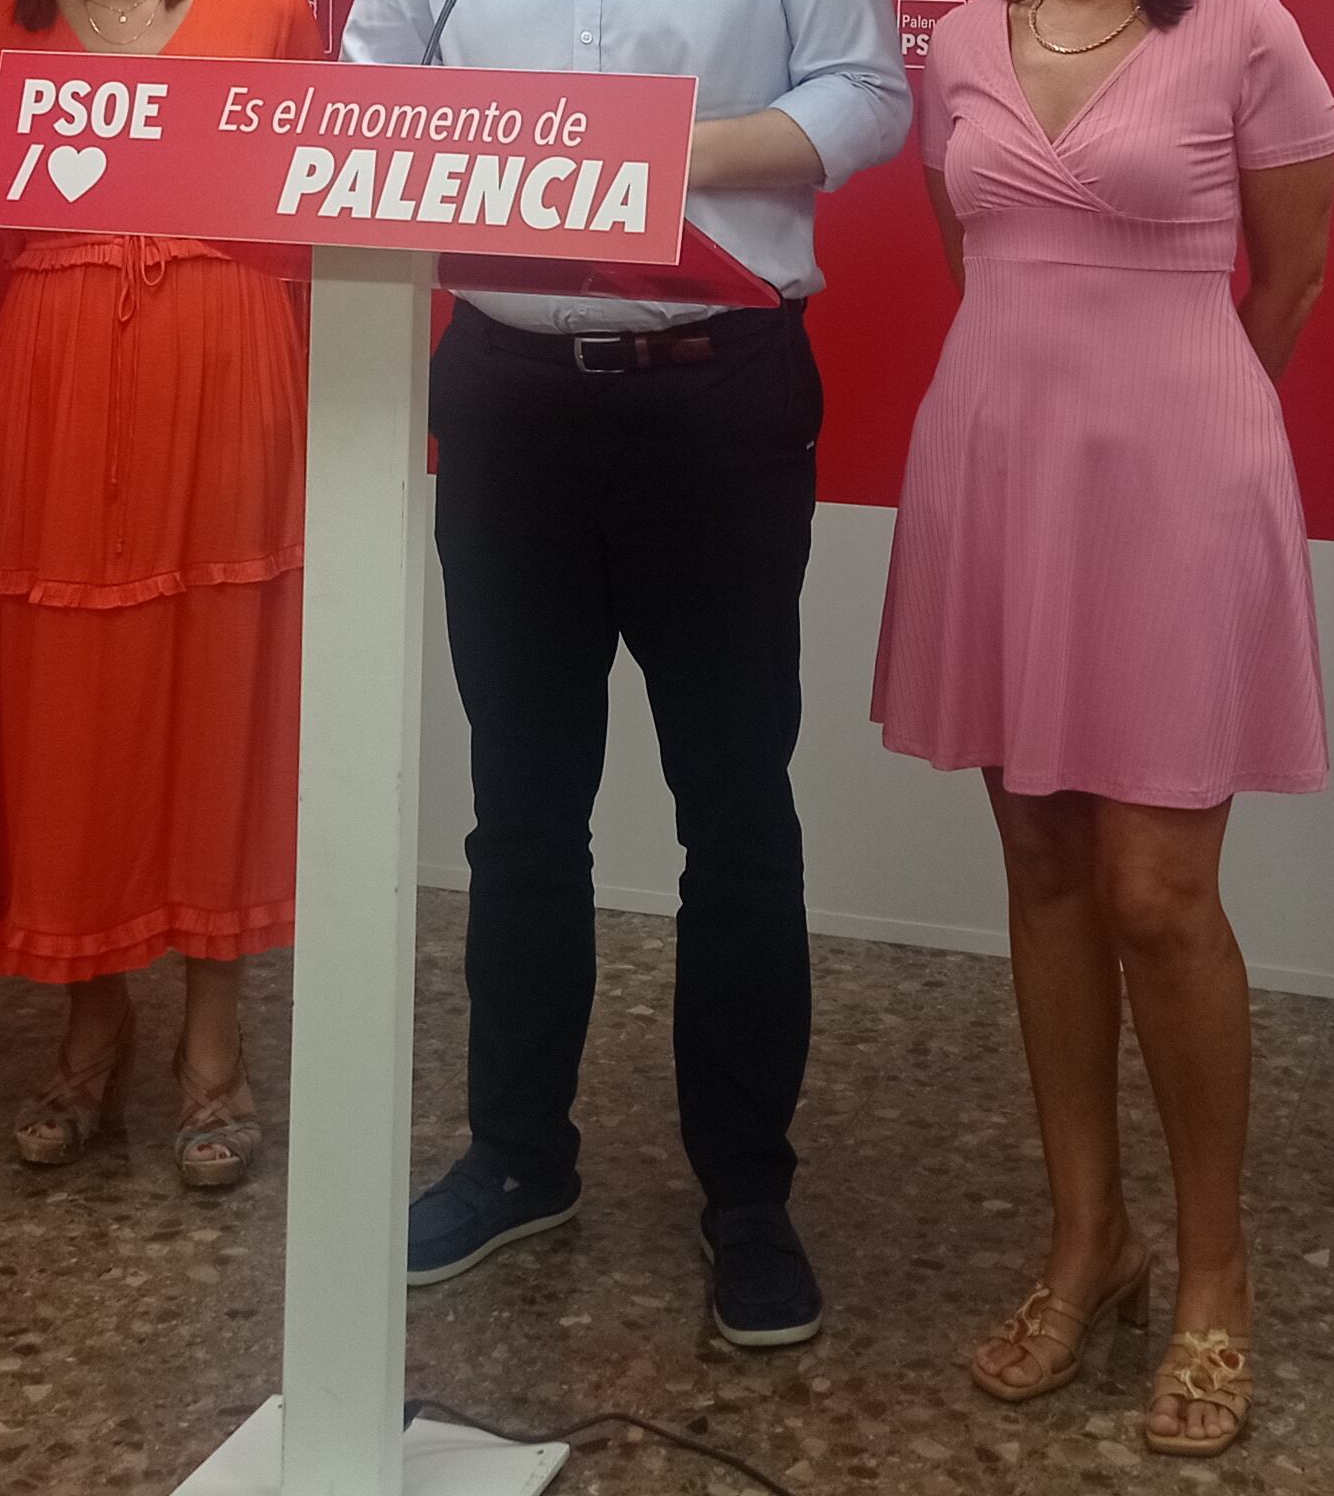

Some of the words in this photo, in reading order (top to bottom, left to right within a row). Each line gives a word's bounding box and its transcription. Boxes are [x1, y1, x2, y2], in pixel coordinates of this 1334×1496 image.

[901, 33, 930, 56] PS
[902, 14, 935, 29] Palen
[16, 78, 169, 140] PSOE
[218, 86, 264, 133] Es
[271, 86, 315, 135] el
[318, 101, 522, 145] momento
[533, 96, 588, 147] de
[275, 145, 649, 233] PALENCIA
